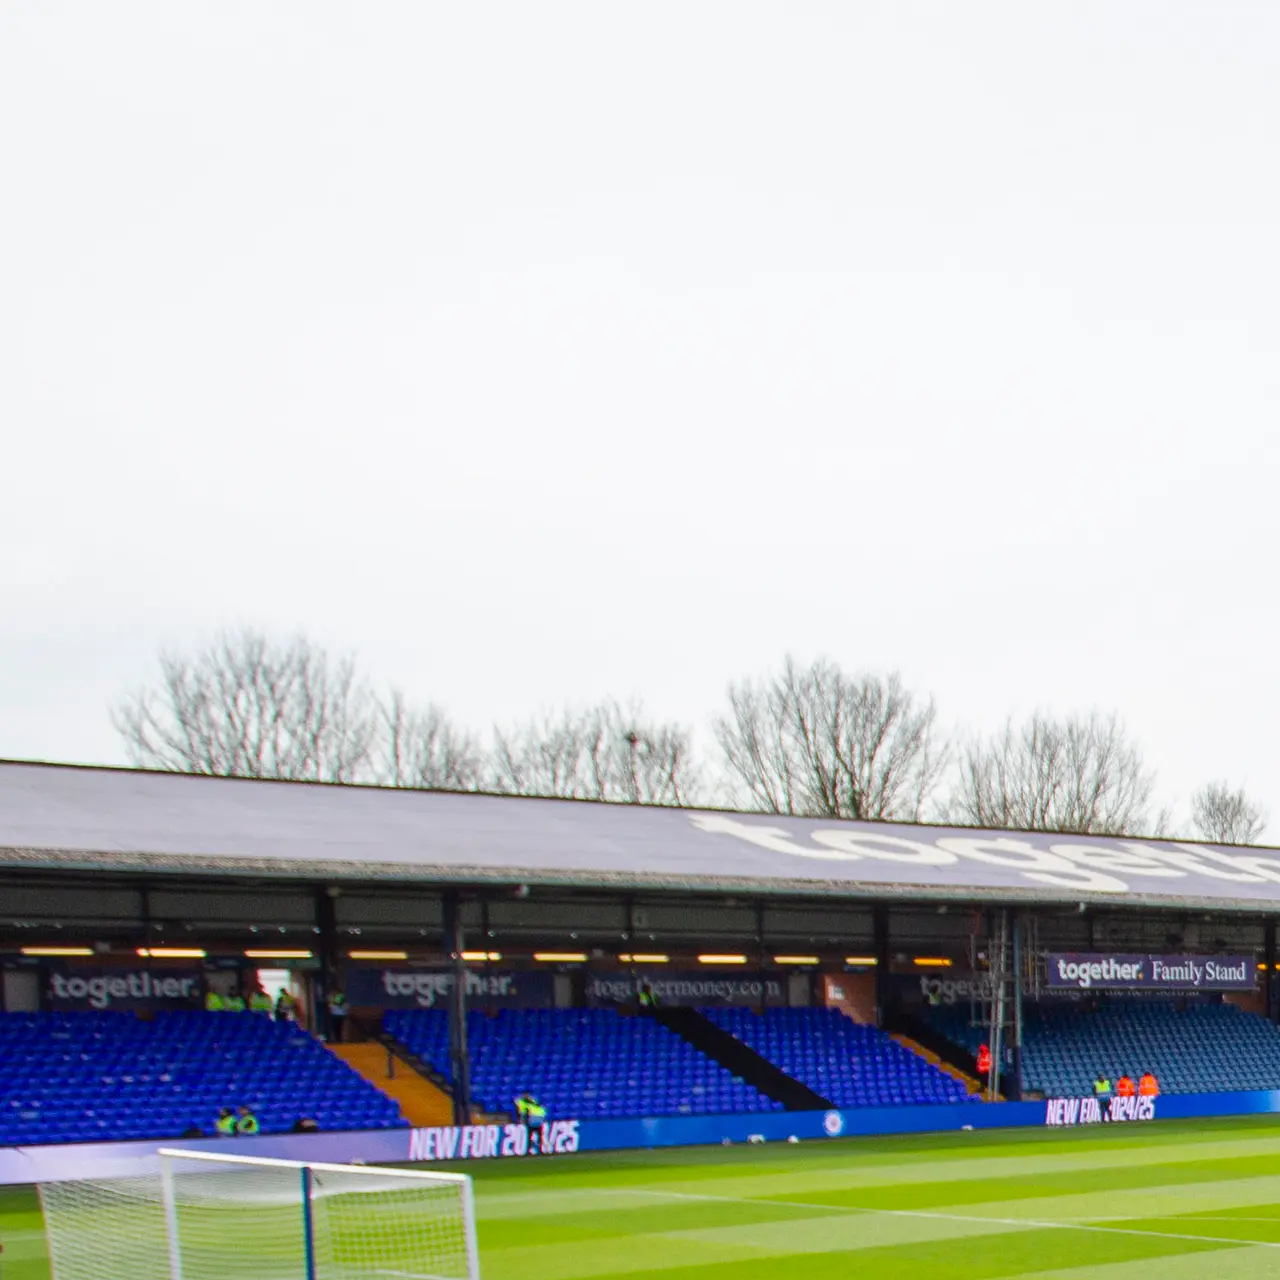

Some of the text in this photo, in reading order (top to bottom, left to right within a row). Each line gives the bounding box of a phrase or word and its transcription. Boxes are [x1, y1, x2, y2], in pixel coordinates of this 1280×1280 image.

[382, 971, 518, 1007] togeher.
[1057, 958, 1247, 988] together. Family Stand
[1046, 1098, 1080, 1125] NEW
[1104, 1095, 1156, 1122] 024/25
[410, 1120, 580, 1162] NEW FOR 204/25
